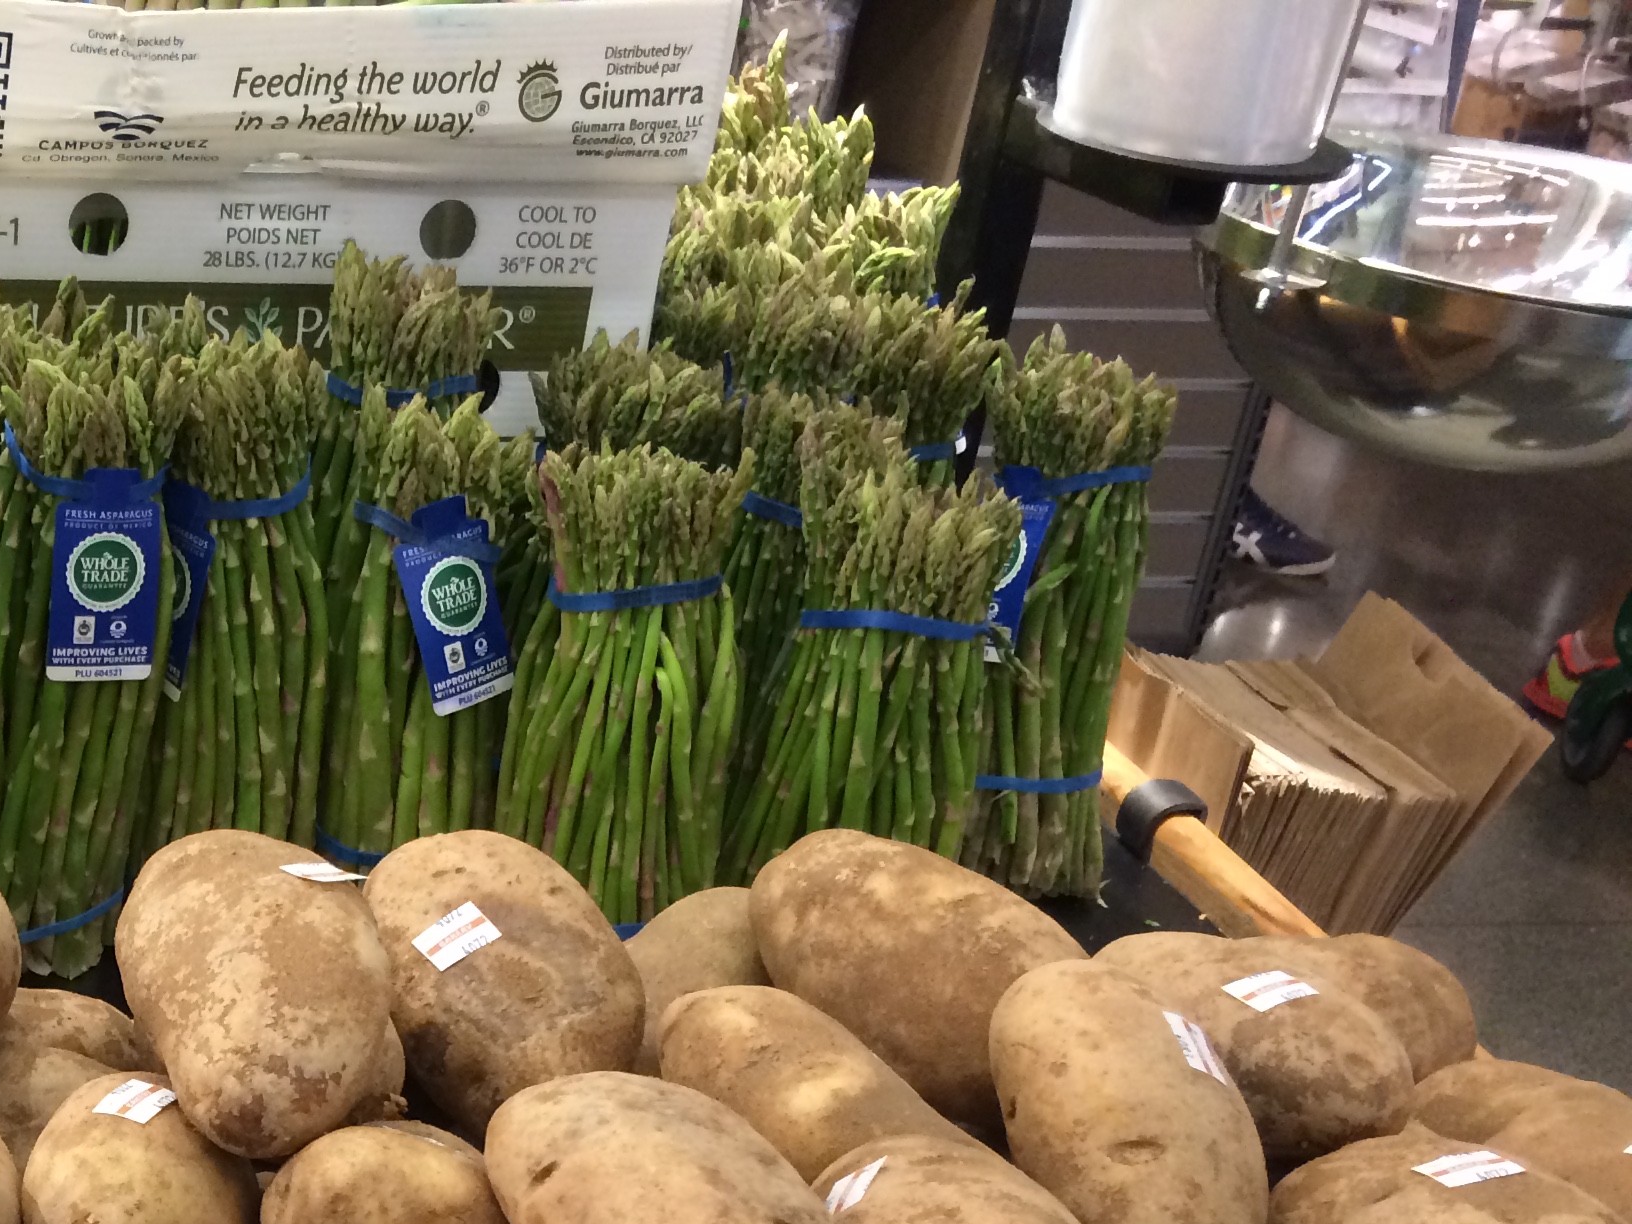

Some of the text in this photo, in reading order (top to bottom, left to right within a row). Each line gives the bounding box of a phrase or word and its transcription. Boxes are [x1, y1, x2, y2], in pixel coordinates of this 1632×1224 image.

[70, 42, 108, 55] Cultivés
[137, 35, 171, 47] packed
[173, 36, 185, 47] by
[604, 43, 671, 60] Distributed
[606, 61, 682, 78] Distribué par
[233, 59, 502, 102] Feeding the world
[579, 80, 704, 110] Giumarra
[235, 111, 262, 133] in
[271, 116, 289, 132] a
[298, 102, 407, 135] healthy
[571, 119, 626, 134] Giumarra
[629, 117, 681, 133] Borquez,
[38, 139, 114, 151] CAMPOS
[572, 129, 699, 147] Escondico, CA 92027
[575, 146, 689, 160] www.giumarra.com
[219, 202, 332, 222] NET WEIGHT
[518, 204, 598, 224] COOL TO
[225, 226, 322, 246] POIDS NET
[515, 230, 594, 250] COOL DE
[202, 250, 308, 272] 28 LBS. (12.7
[498, 256, 536, 275] 36°F
[539, 256, 565, 275] OR
[65, 508, 153, 520] FRESH ASPARAGUS
[80, 556, 130, 571] WHOLE
[81, 569, 129, 583] TRADE
[431, 576, 476, 601] WHOLE
[436, 589, 478, 612] TRADE
[51, 655, 147, 665] WITH EVERY PURCHASE
[52, 645, 148, 658] IMPROVING LIVES
[74, 669, 92, 678] PLU
[433, 655, 508, 692] IMPROVING LIVES
